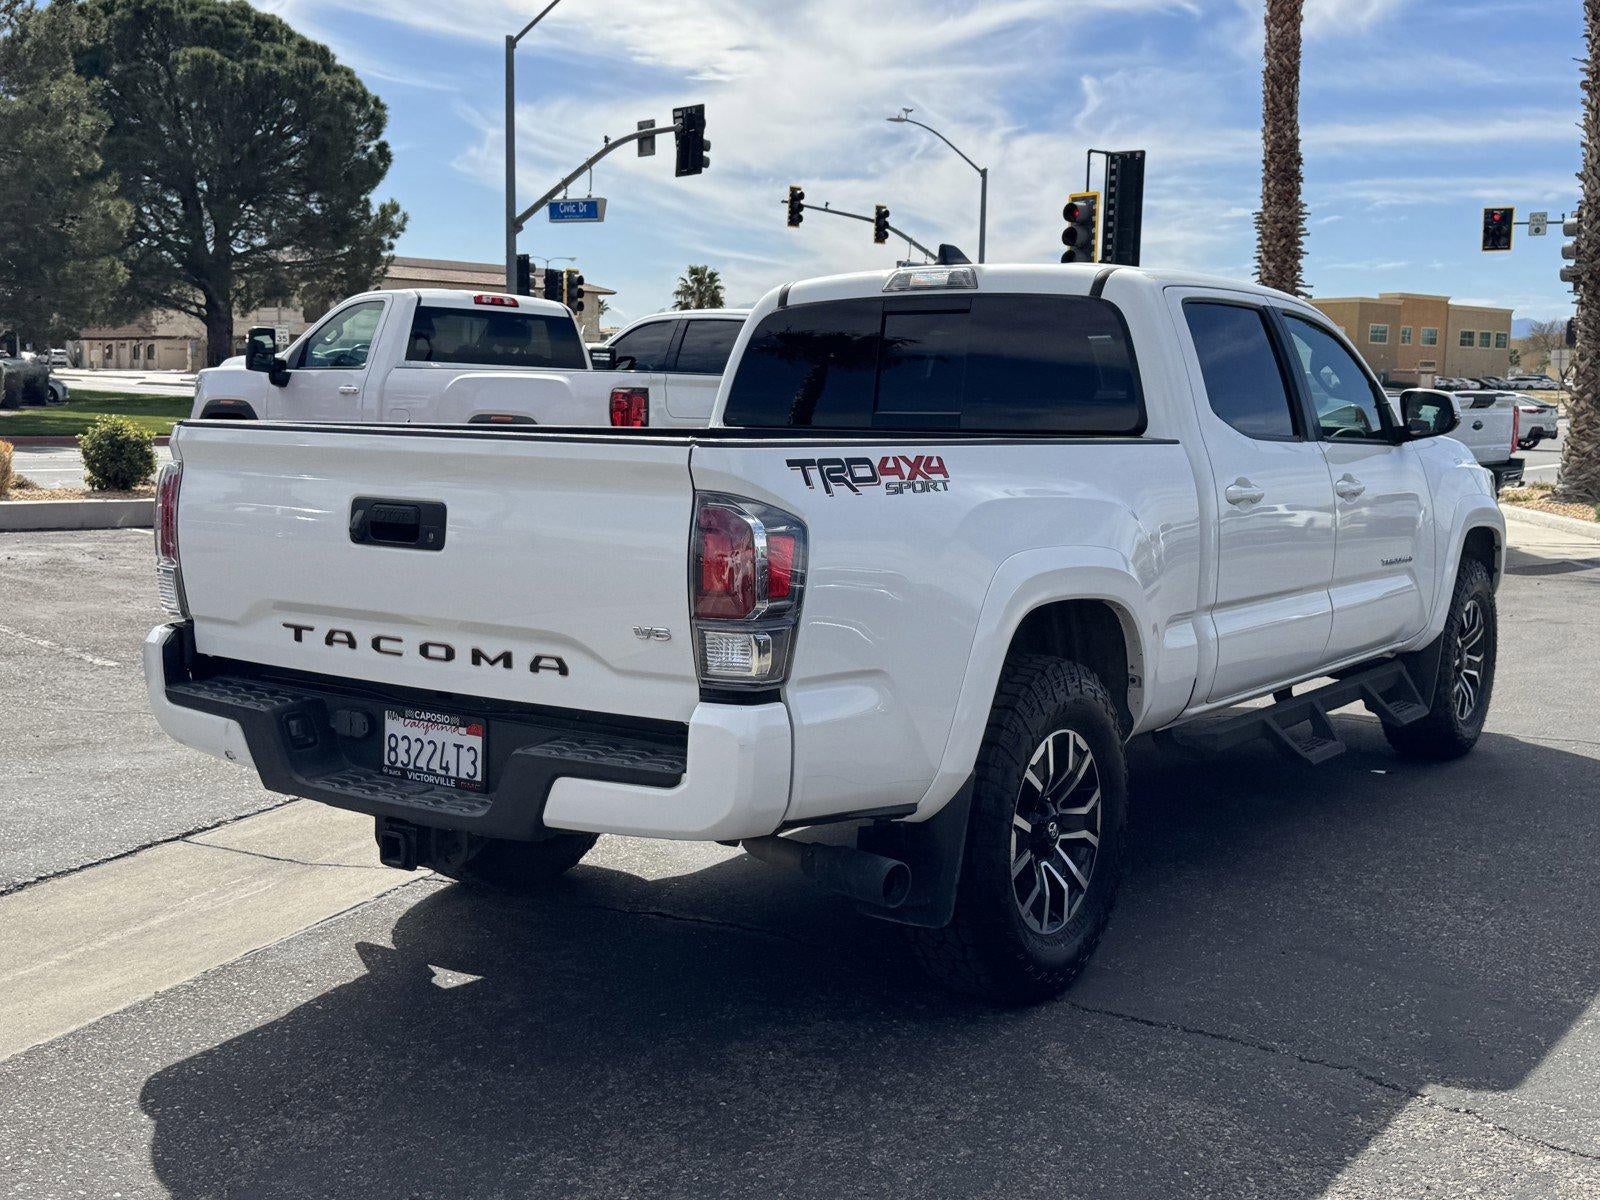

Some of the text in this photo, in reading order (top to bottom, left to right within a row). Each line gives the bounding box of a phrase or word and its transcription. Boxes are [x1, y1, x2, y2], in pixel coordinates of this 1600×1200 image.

[559, 202, 587, 213] Civic Dr
[277, 335, 288, 343] 35
[785, 457, 881, 497] TRD
[885, 479, 950, 496] SPORT
[632, 626, 672, 641] V6
[282, 622, 570, 677] TACOMA
[414, 710, 450, 724] CAPOSIO
[387, 733, 478, 779] 83224T3
[406, 770, 456, 787] VICTORVILLE
